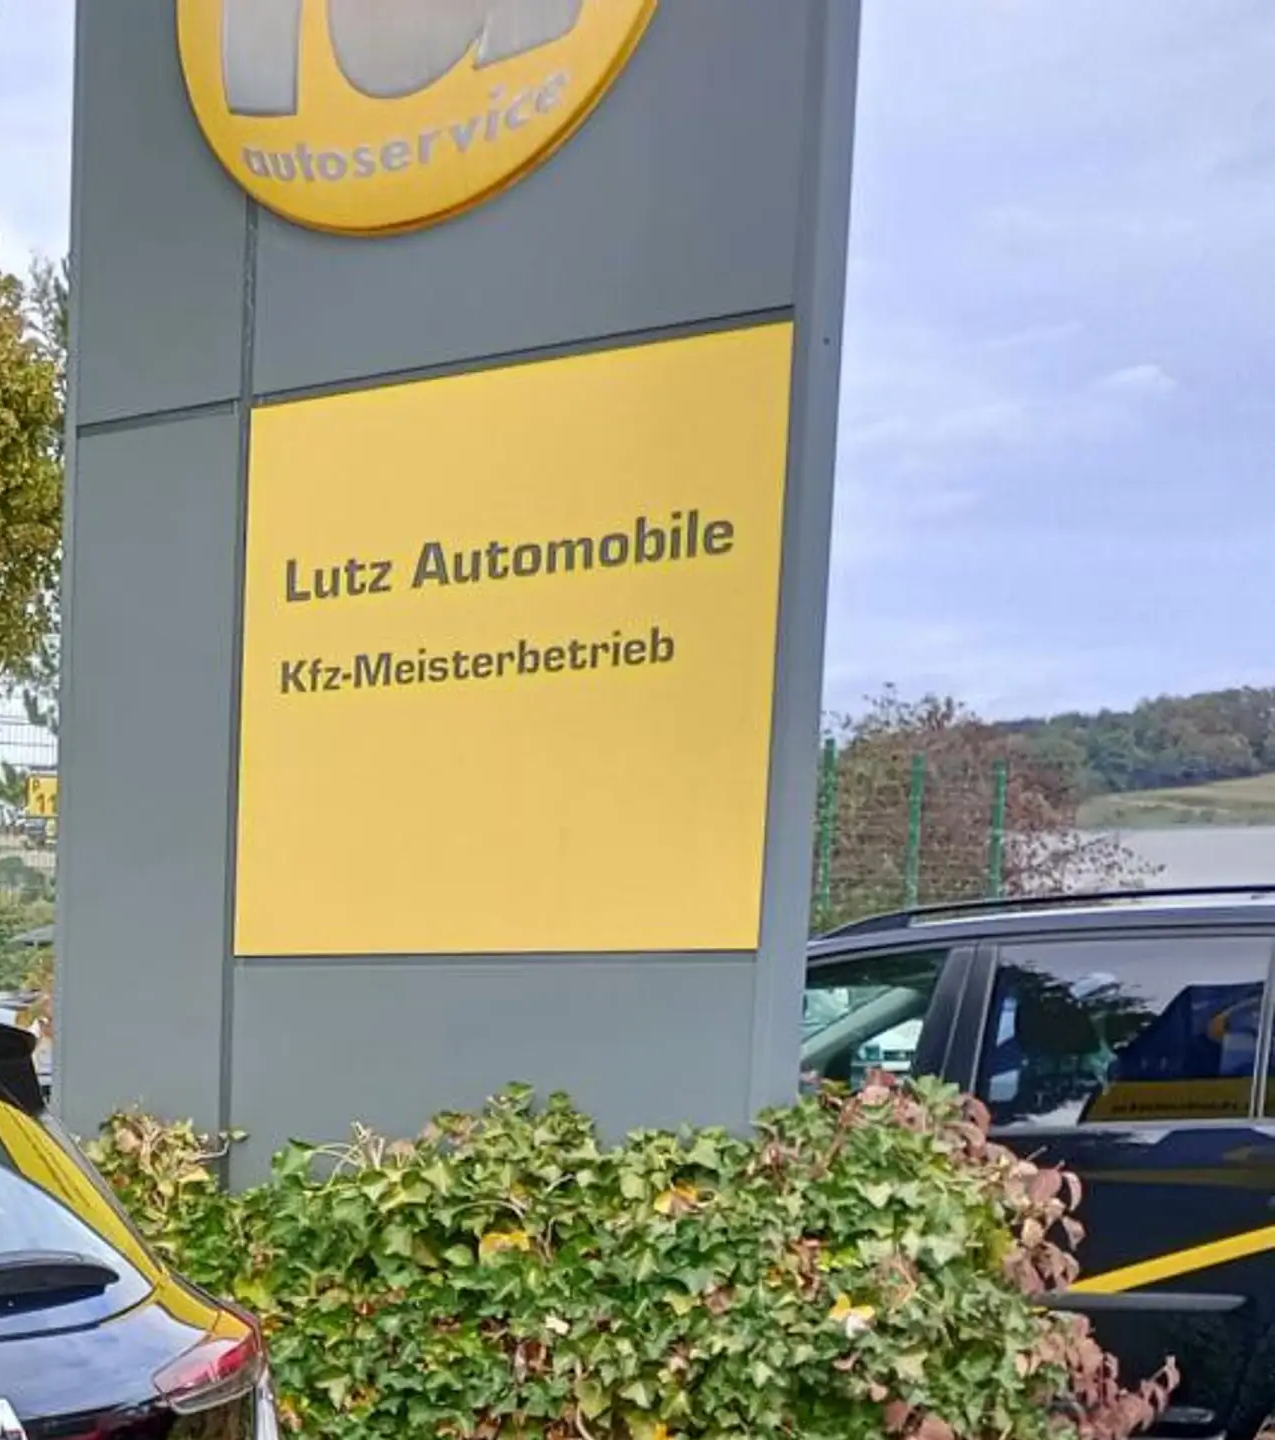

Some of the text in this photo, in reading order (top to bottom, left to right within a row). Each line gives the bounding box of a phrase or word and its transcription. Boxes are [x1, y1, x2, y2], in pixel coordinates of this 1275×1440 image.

[243, 72, 567, 182] autoservice
[286, 509, 734, 602] Lutz Automobile
[280, 627, 675, 694] Kfz-Meisterbetrieb
